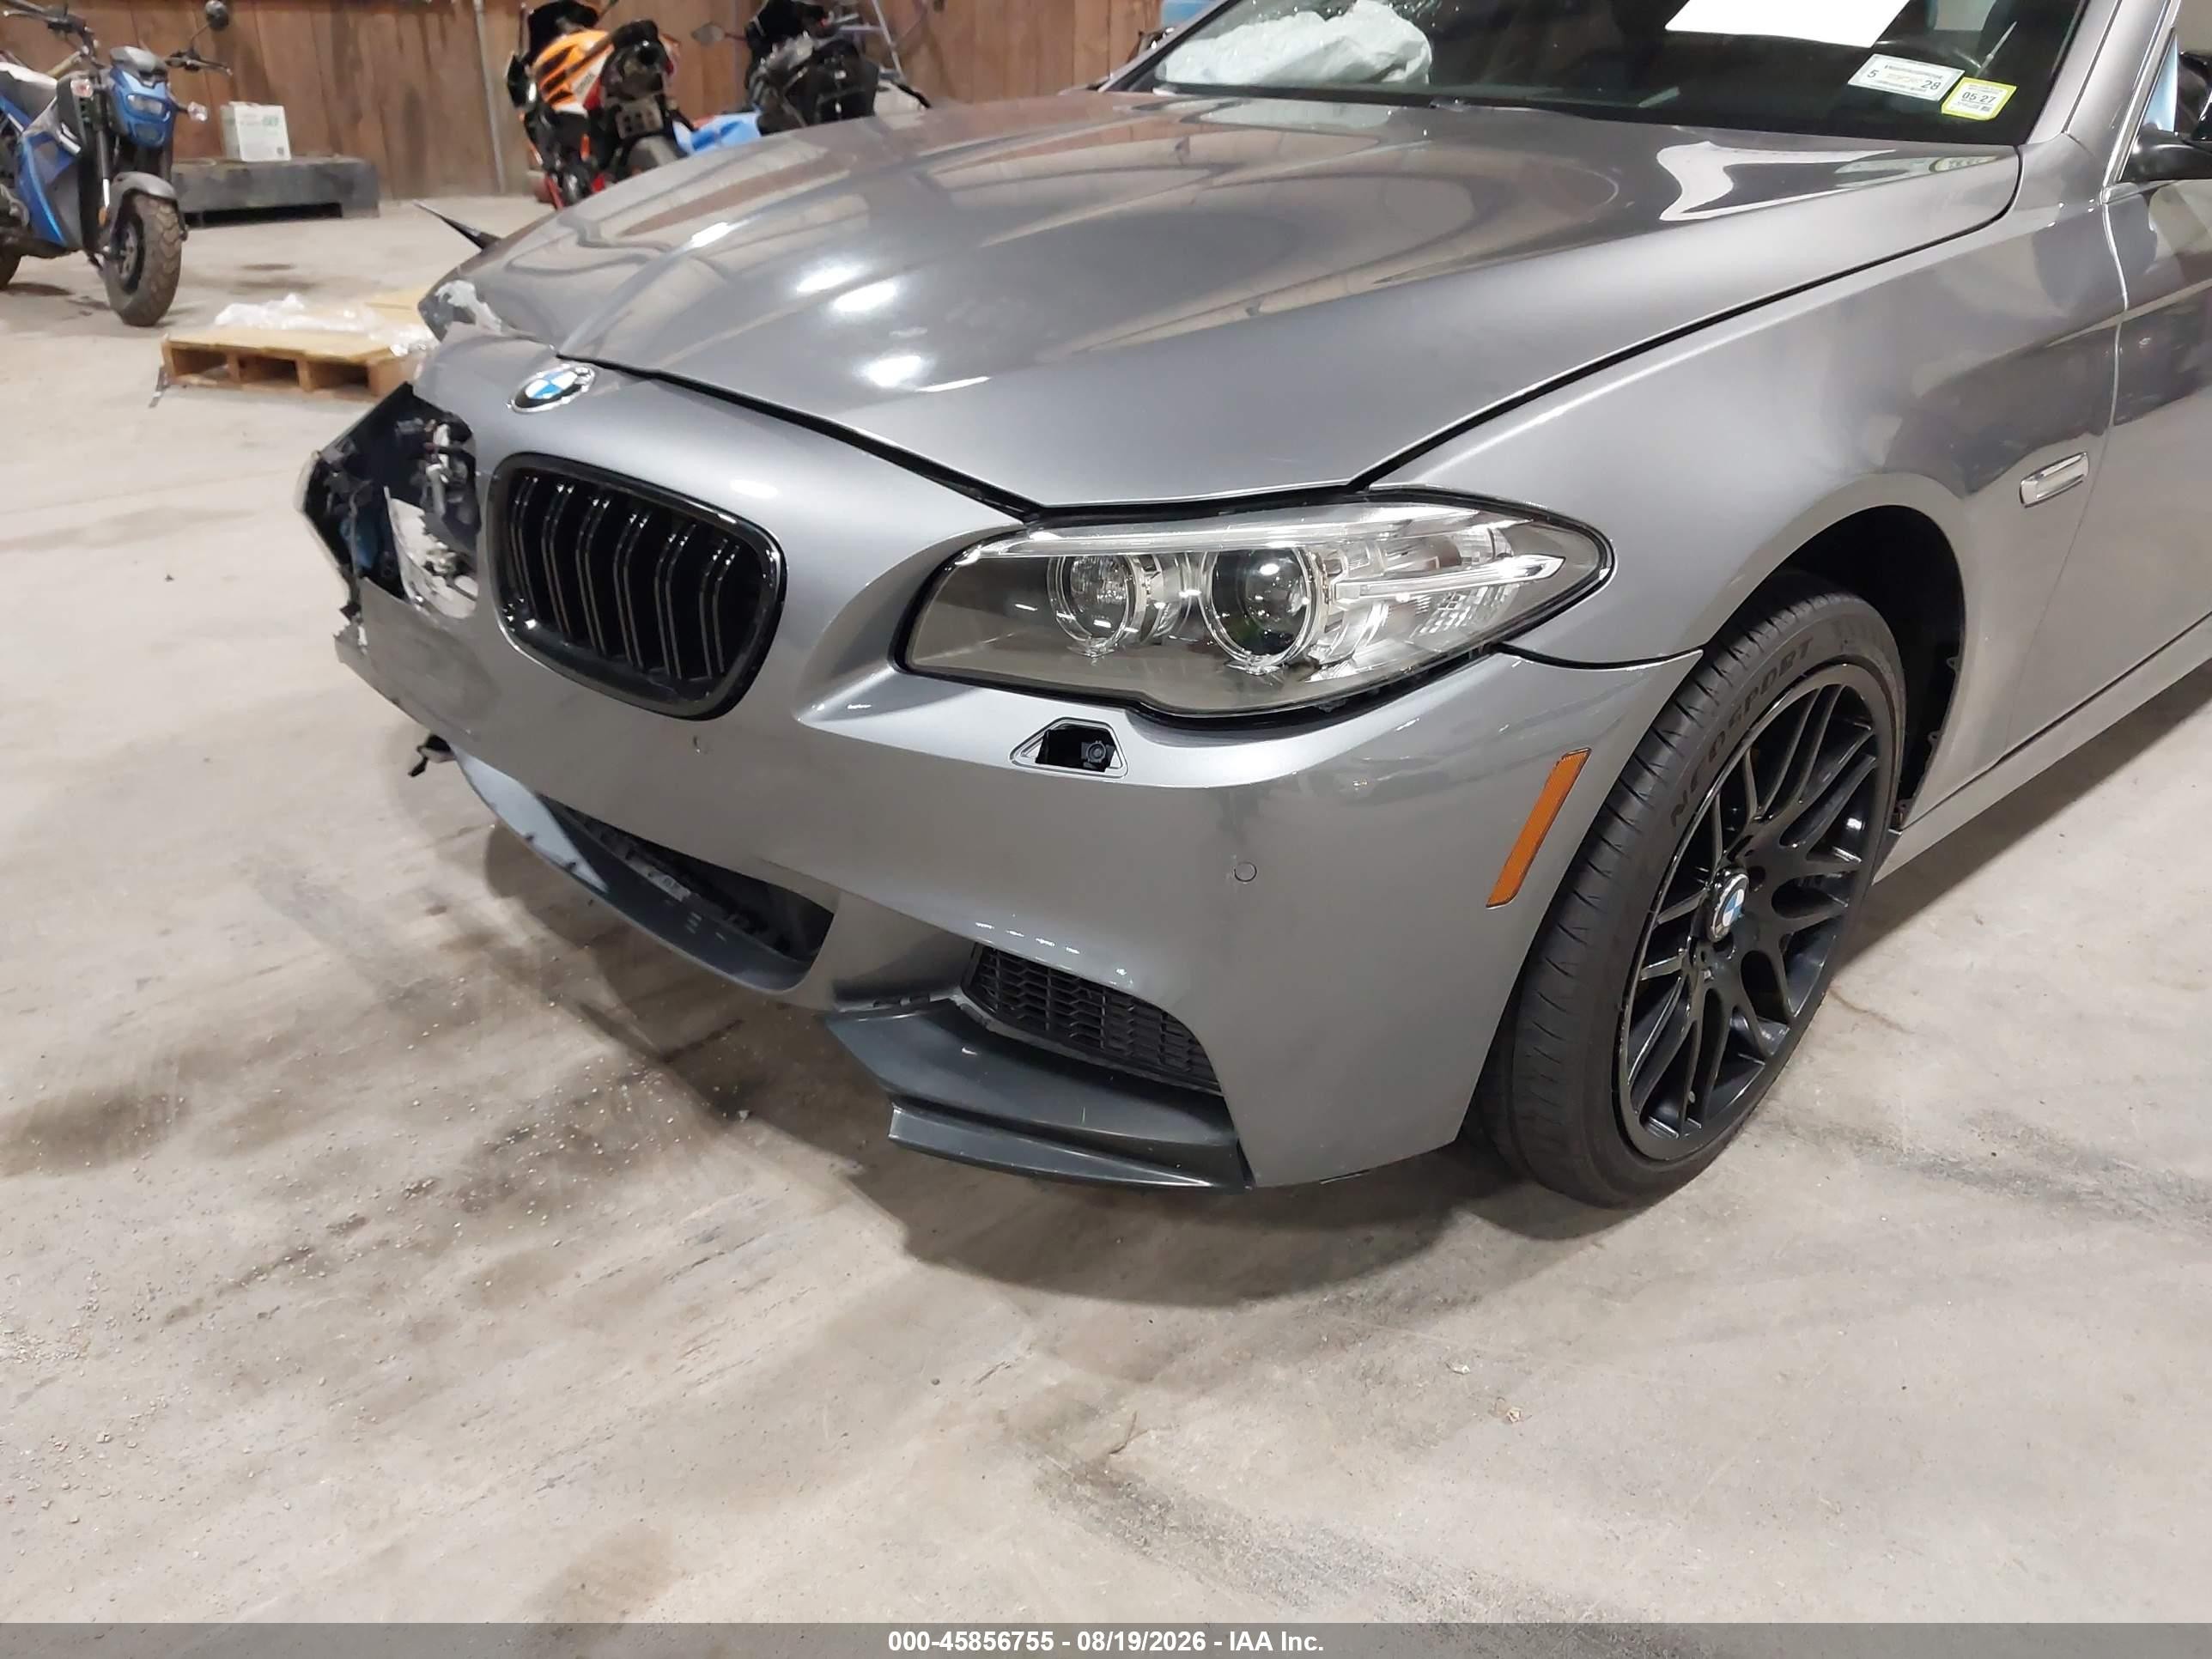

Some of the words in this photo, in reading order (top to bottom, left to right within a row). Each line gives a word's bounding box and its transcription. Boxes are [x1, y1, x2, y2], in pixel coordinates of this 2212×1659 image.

[1867, 69, 1879, 78] 5
[1921, 80, 1942, 91] 28
[1961, 91, 1978, 101] 05
[1979, 95, 1996, 104] 27
